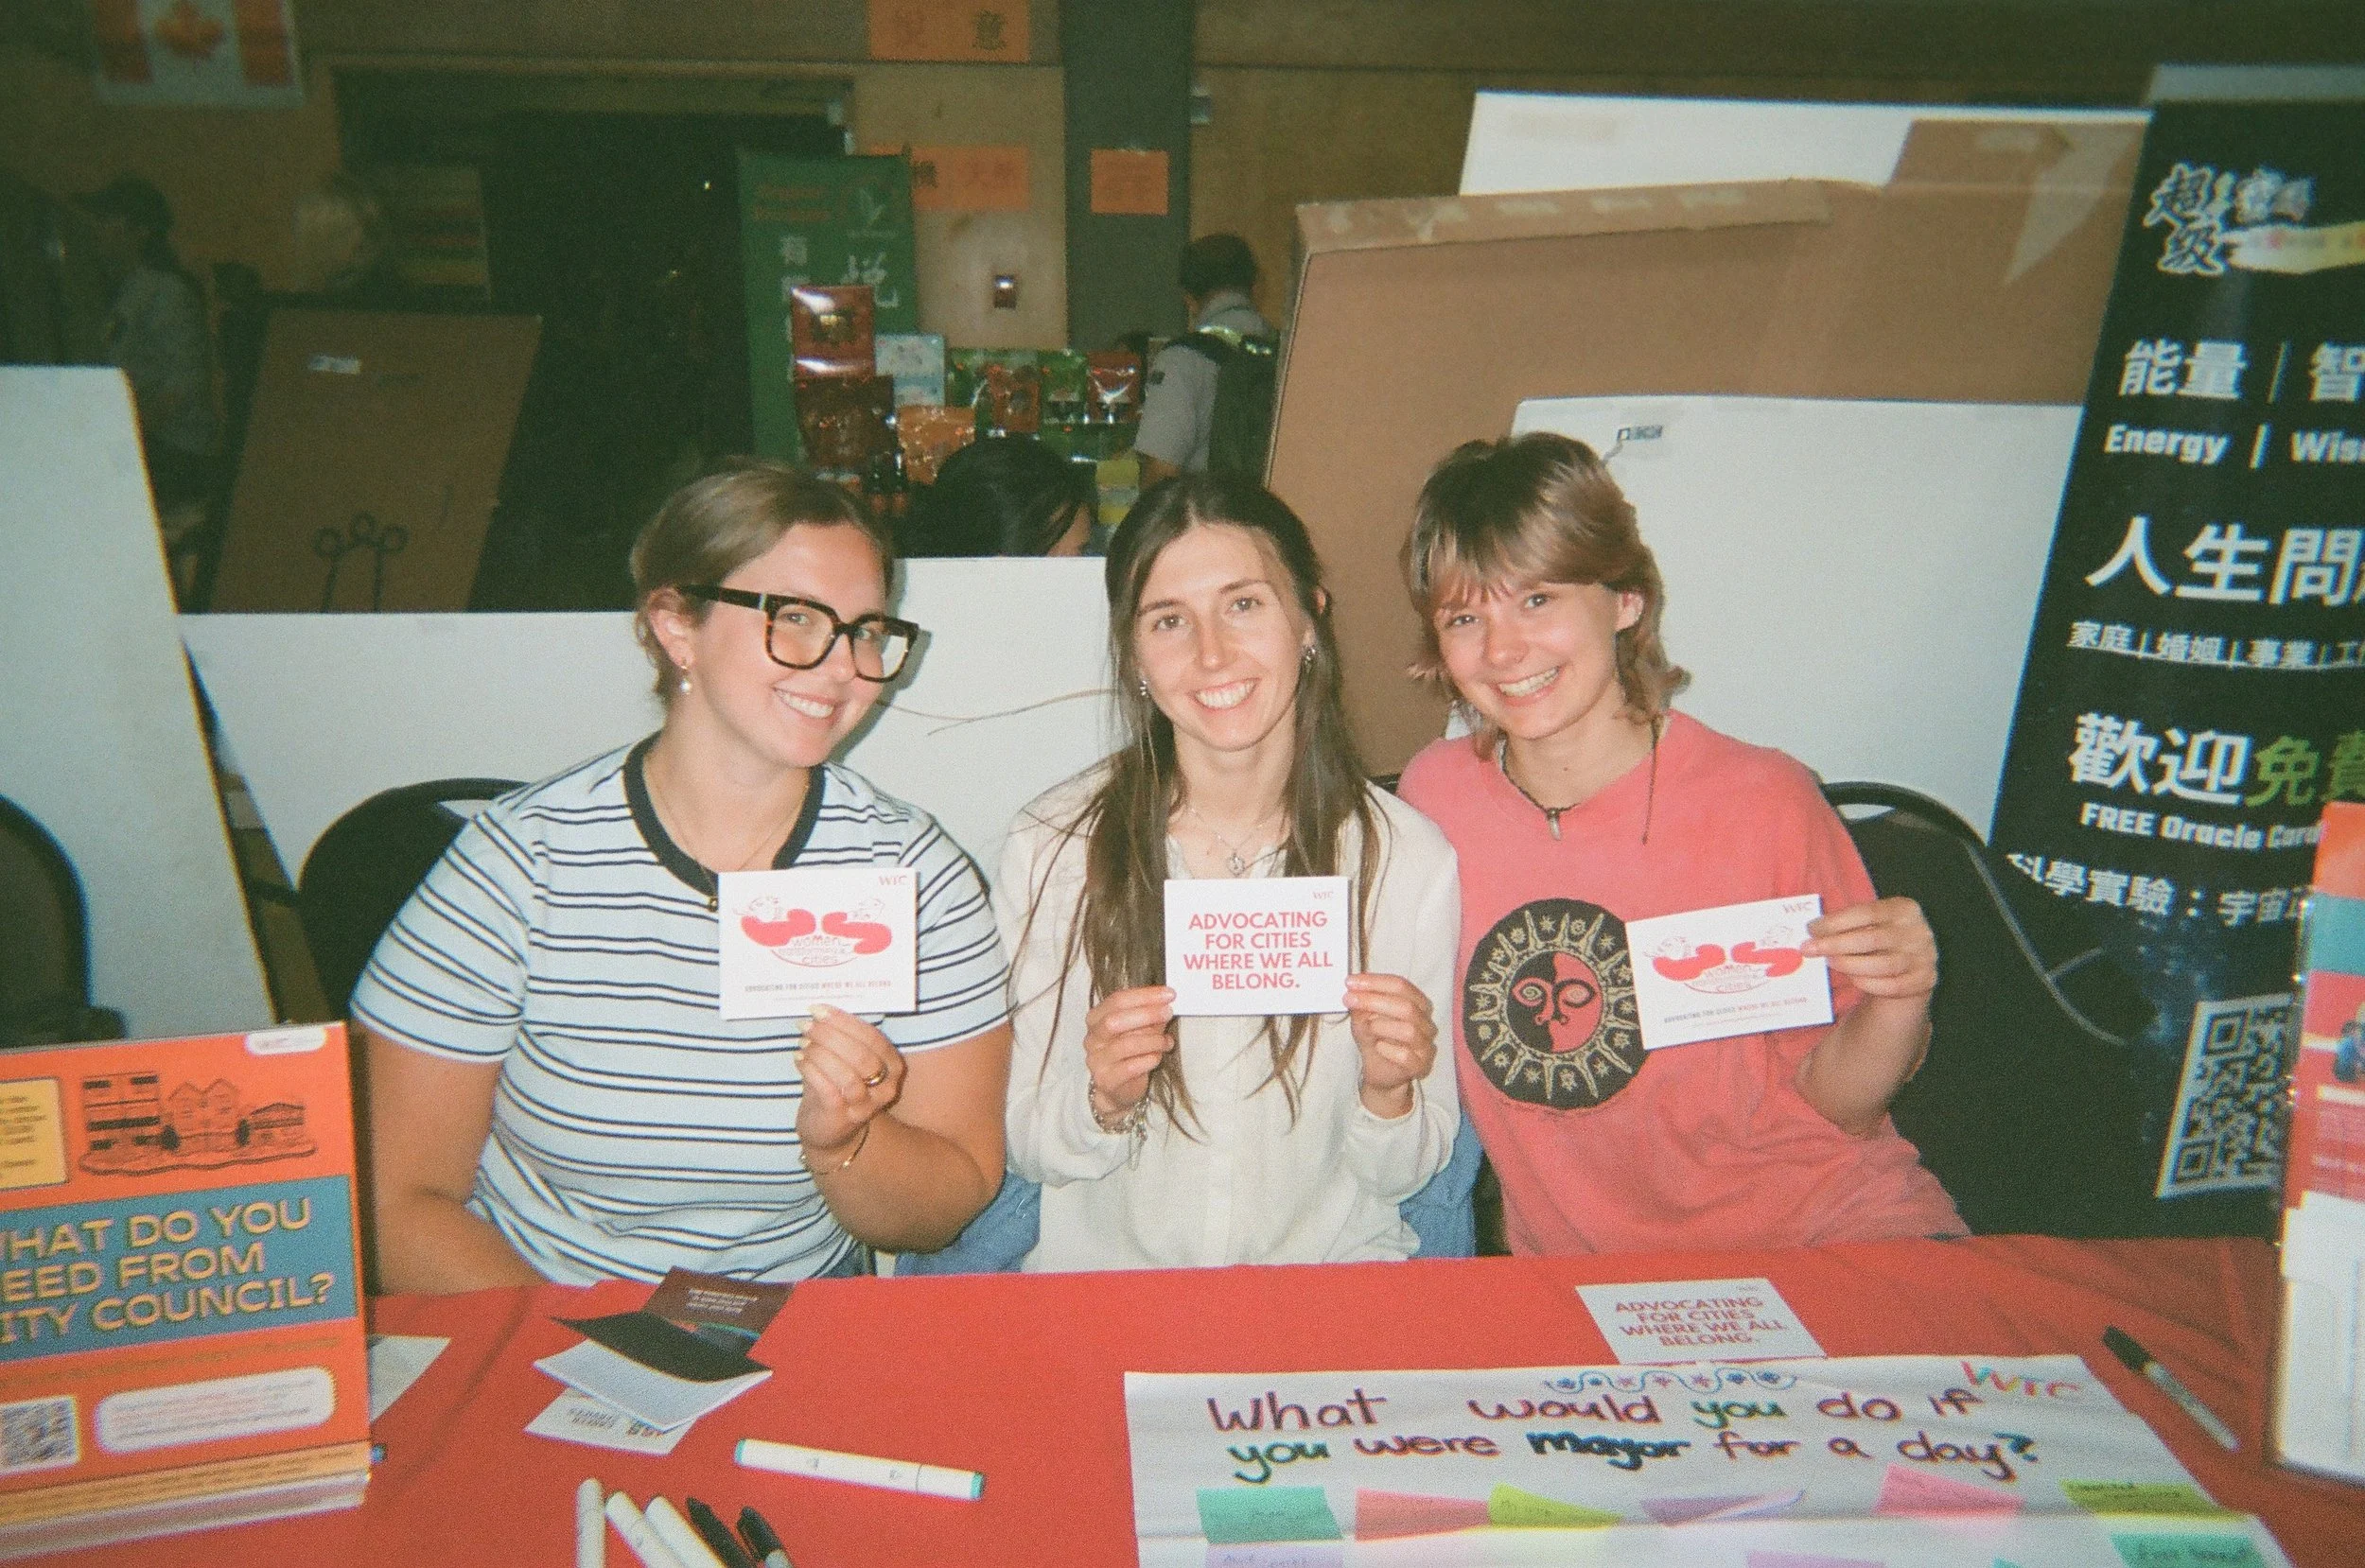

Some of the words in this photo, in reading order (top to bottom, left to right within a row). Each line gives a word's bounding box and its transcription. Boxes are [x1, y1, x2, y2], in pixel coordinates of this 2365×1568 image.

[2118, 339, 2246, 400] 能量
[2104, 424, 2230, 465] Energy
[2289, 430, 2365, 463] Wis
[2085, 514, 2365, 607] 人生問
[2080, 802, 2155, 836] FREE
[2160, 815, 2264, 850] Oracle
[1188, 911, 1328, 931] ADVOCATING
[1204, 933, 1245, 950] FOR
[1251, 932, 1312, 950] CITIES
[1183, 953, 1253, 970] WHERE
[1260, 952, 1292, 969] WE
[1297, 951, 1333, 968] ALL
[1212, 972, 1301, 990] BELONG.
[0, 1218, 114, 1262] HAT
[128, 1210, 197, 1249] DO
[213, 1196, 311, 1235] YOU
[117, 1244, 266, 1290] FROM
[92, 1273, 336, 1333] COUNCIL?
[1615, 1297, 1763, 1314] ADVOCATING
[1637, 1312, 1682, 1324] FOR
[1688, 1309, 1756, 1322] CITIES
[1619, 1324, 1697, 1337] WHERE
[1705, 1321, 1742, 1333] WE
[1748, 1319, 1788, 1332] ALL
[1659, 1332, 1761, 1347] BELONG.
[1207, 1387, 1387, 1433] What
[1467, 1393, 1662, 1423] would
[1689, 1395, 1788, 1429] you
[1816, 1391, 1901, 1422] do
[1926, 1386, 1984, 1417] if
[1228, 1437, 1331, 1485] you
[1352, 1432, 1500, 1457] were
[1524, 1430, 1691, 1472] mayor
[1717, 1430, 1800, 1460] for
[1827, 1437, 1872, 1461] a
[1896, 1429, 2041, 1484] day?
